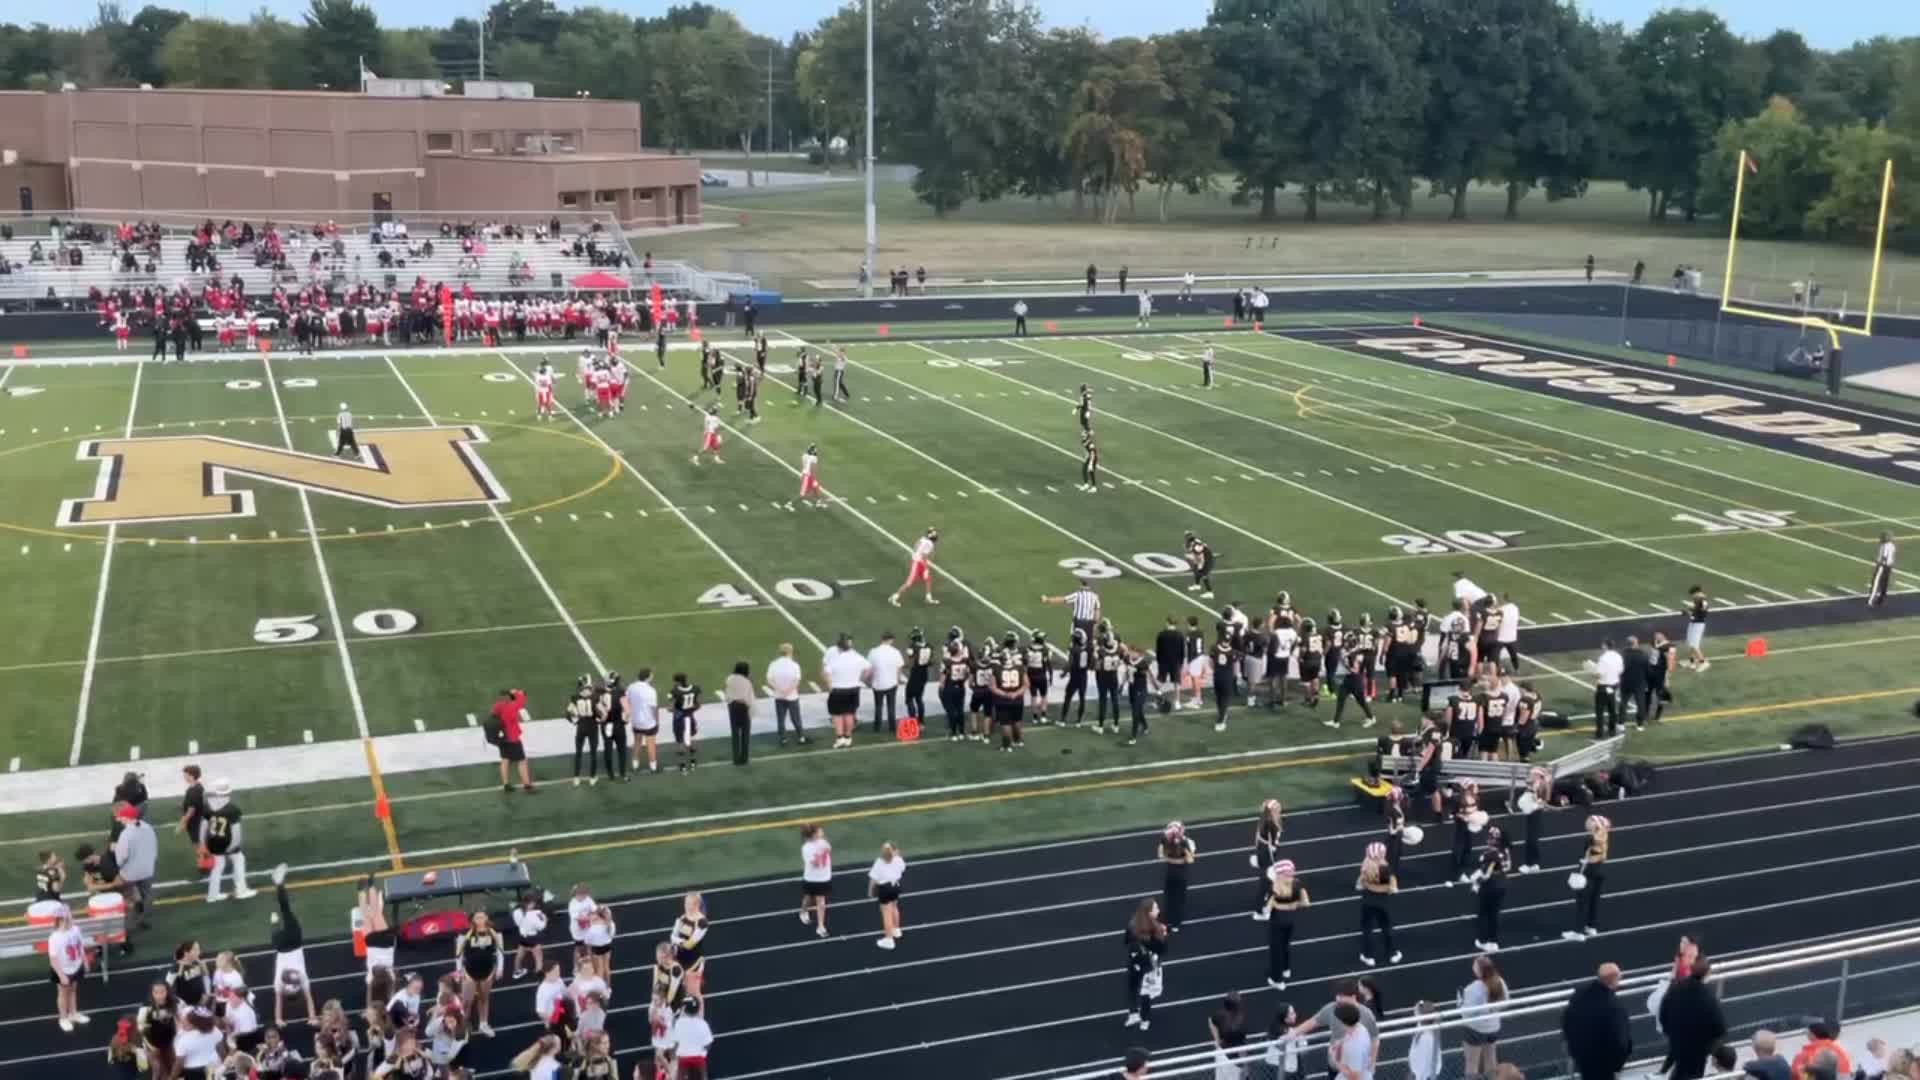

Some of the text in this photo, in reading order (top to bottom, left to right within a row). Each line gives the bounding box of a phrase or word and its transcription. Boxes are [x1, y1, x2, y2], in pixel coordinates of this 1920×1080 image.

[56, 425, 510, 526] N
[1671, 508, 1790, 532] 10
[1381, 529, 1507, 554] 20
[1058, 552, 1190, 580] 30
[697, 577, 835, 607] 40
[253, 608, 417, 643] 50
